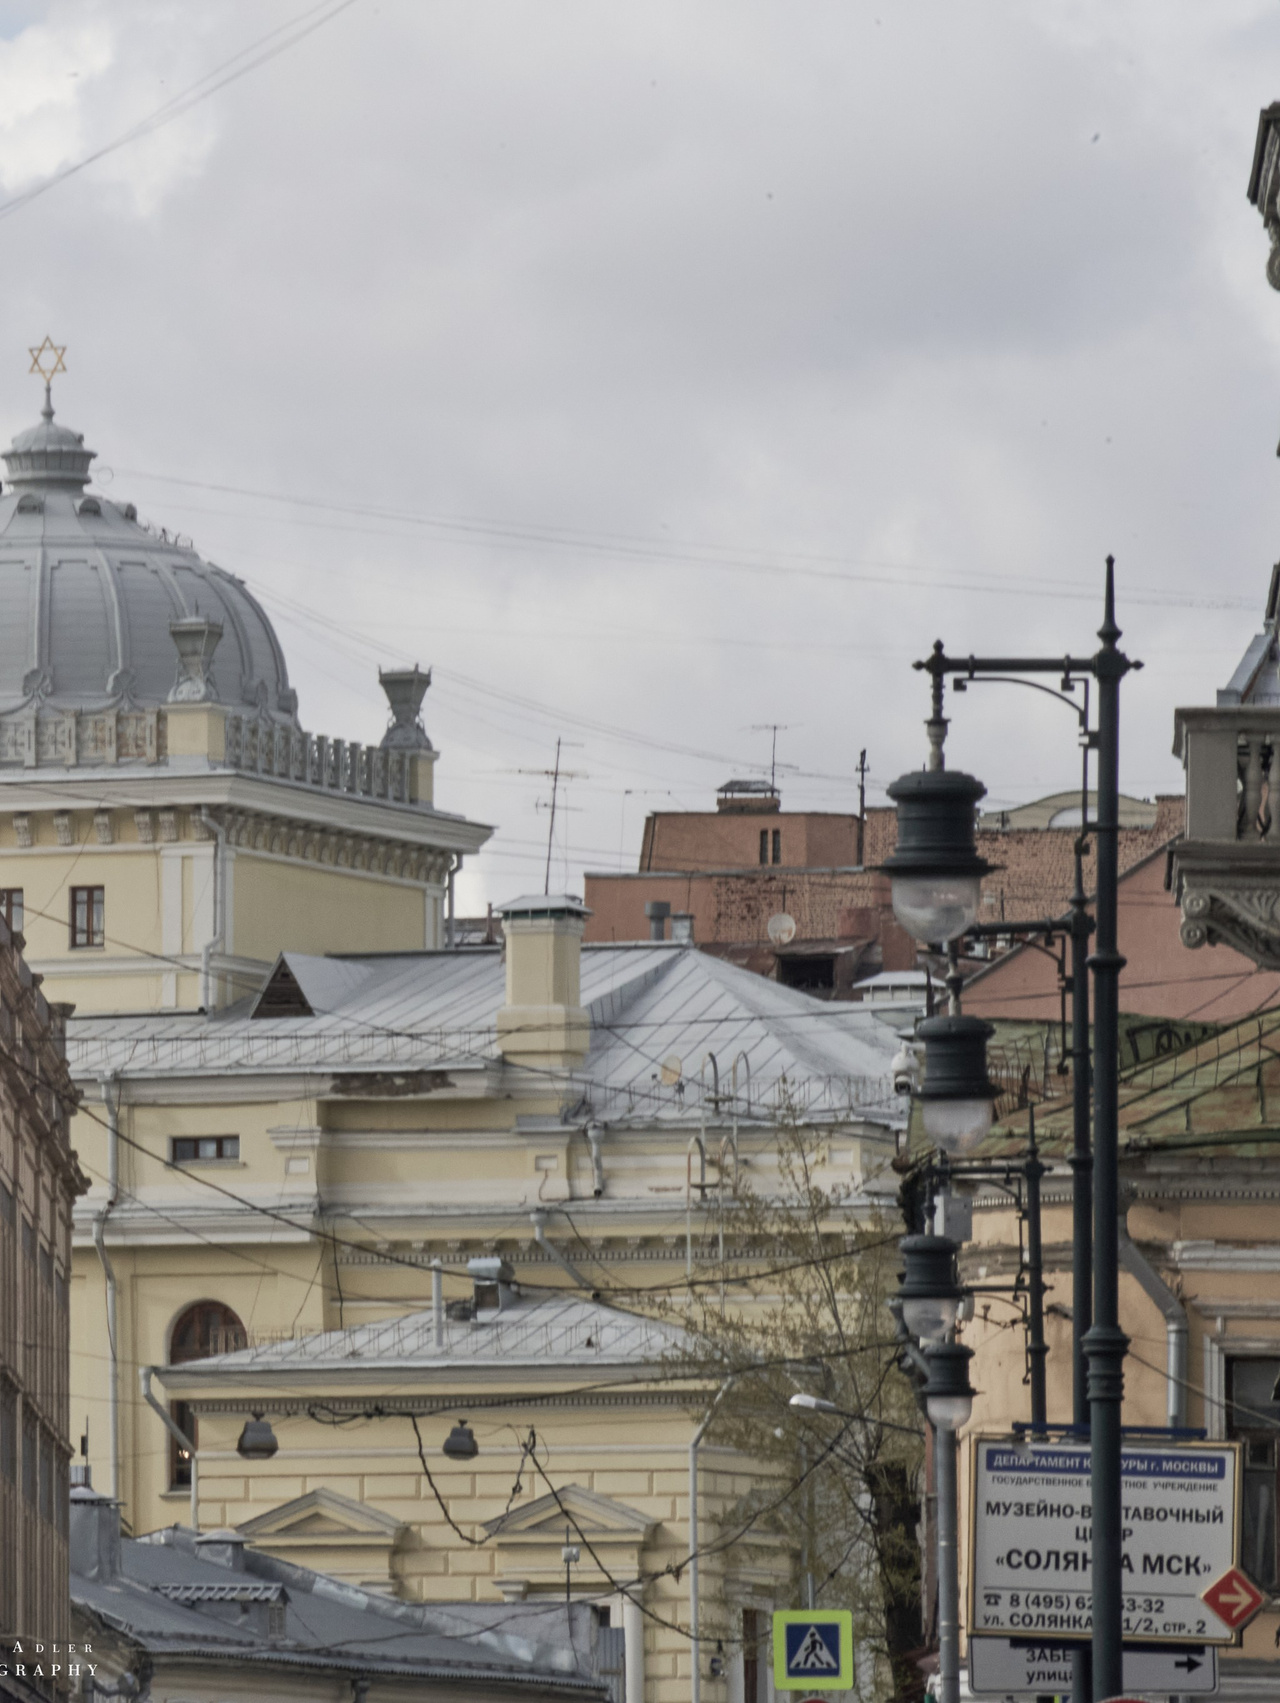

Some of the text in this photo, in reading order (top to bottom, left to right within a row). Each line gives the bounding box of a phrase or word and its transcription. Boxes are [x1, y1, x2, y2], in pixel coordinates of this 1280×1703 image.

[993, 1454, 1081, 1470] ДЕПАРТАМЕНТ
[1083, 1457, 1148, 1472] КУРЫ
[1162, 1460, 1218, 1474] МОСКВЫ
[992, 1475, 1083, 1488] ГОСУДАРСТВЕННОЕ
[1152, 1480, 1218, 1492] УЧРЕЖДЕНИЕ
[985, 1499, 1224, 1524] МУЗЕЙНО-ВТАВОЧНЫЙ
[995, 1548, 1212, 1576] «СОЛЯНА МСК»
[1009, 1593, 1021, 1608] 8
[1025, 1593, 1071, 1612] (495)
[1195, 1619, 1207, 1635] 2
